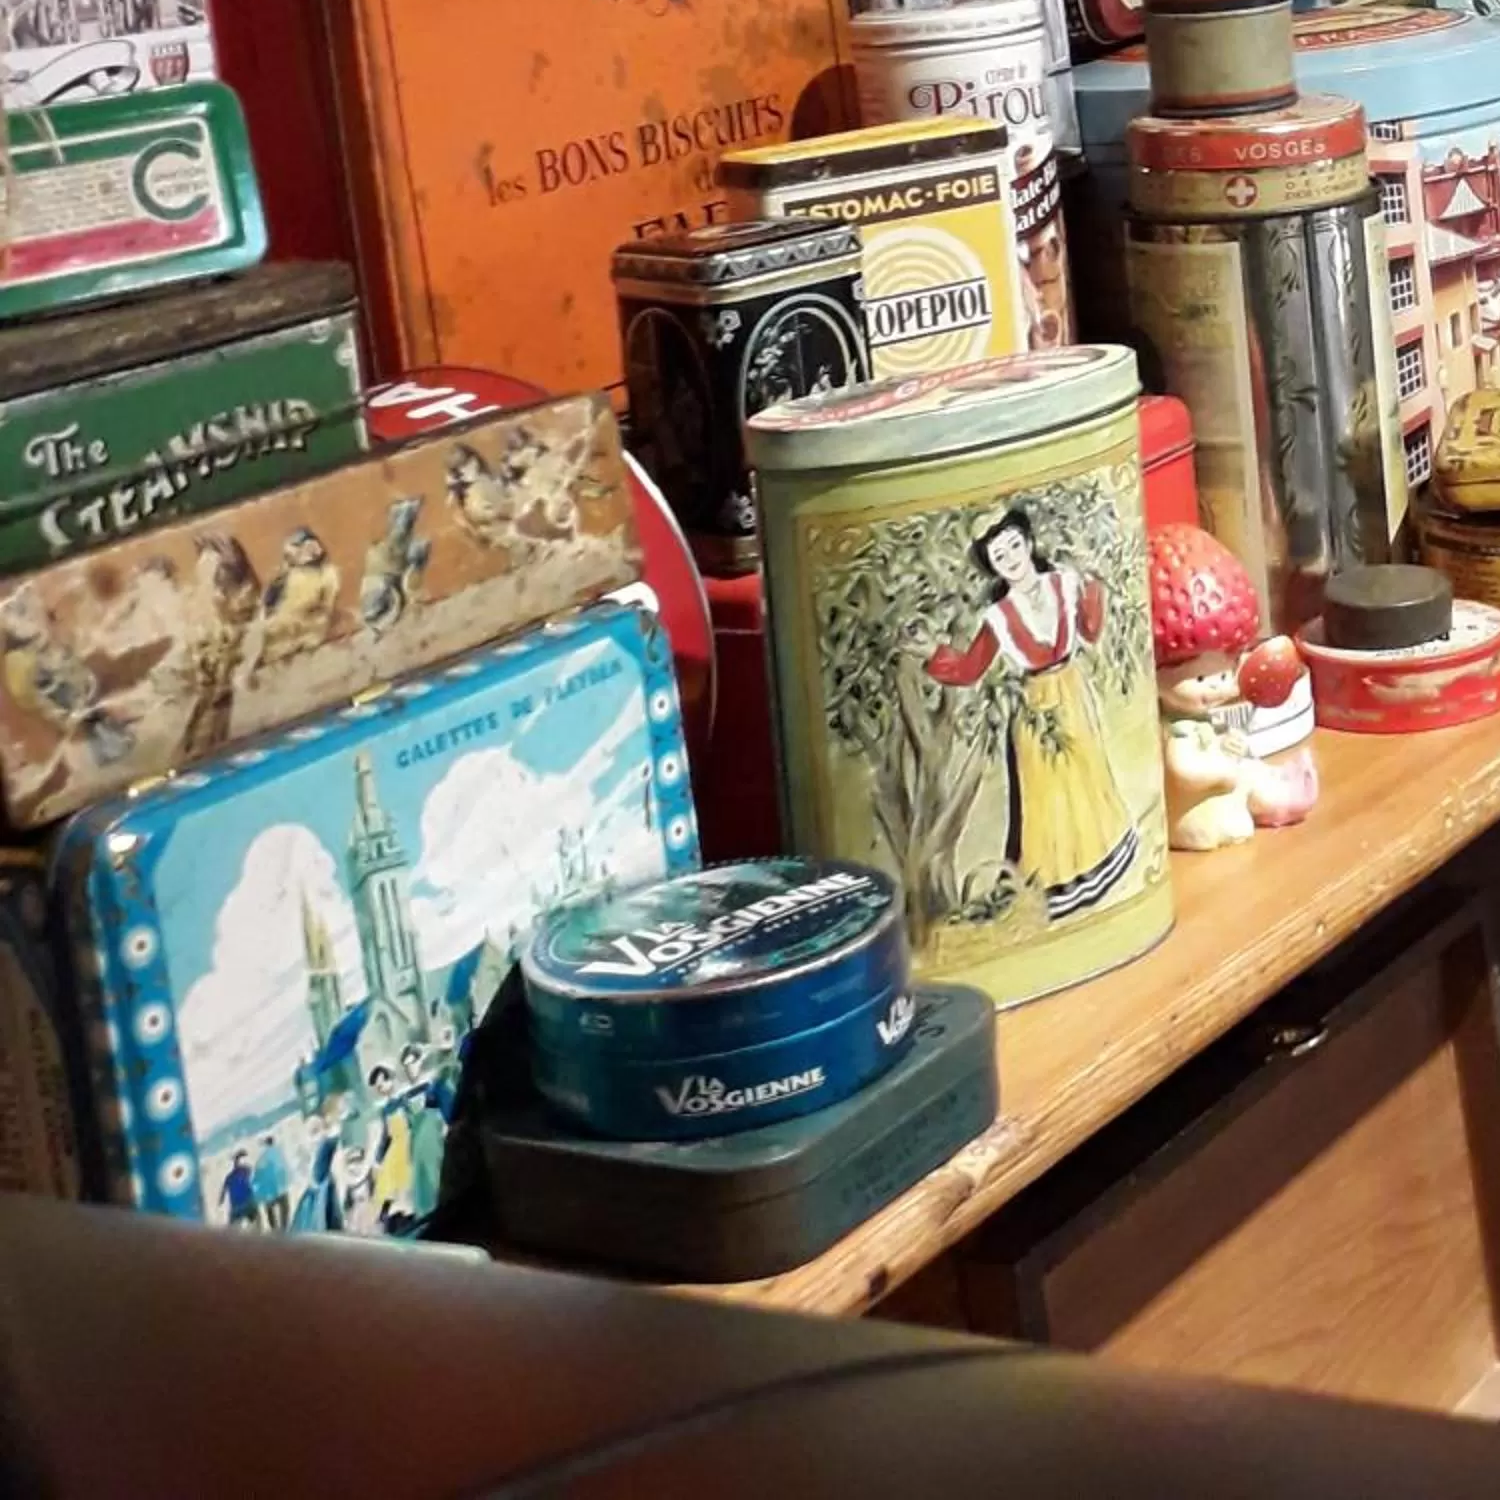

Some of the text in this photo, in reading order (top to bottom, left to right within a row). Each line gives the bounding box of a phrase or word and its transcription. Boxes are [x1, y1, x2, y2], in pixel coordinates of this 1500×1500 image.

[536, 129, 629, 196] BONS
[639, 93, 784, 168] BISCUITS
[1233, 139, 1326, 161] VOSGES
[784, 172, 998, 222] ESTOMAC-FOIE
[867, 283, 992, 341] OPEPTOL
[23, 421, 109, 477] The
[396, 711, 498, 769] GALETTES
[575, 871, 871, 976] VOSGIENNE
[655, 1066, 827, 1116] VOSGIENNE
